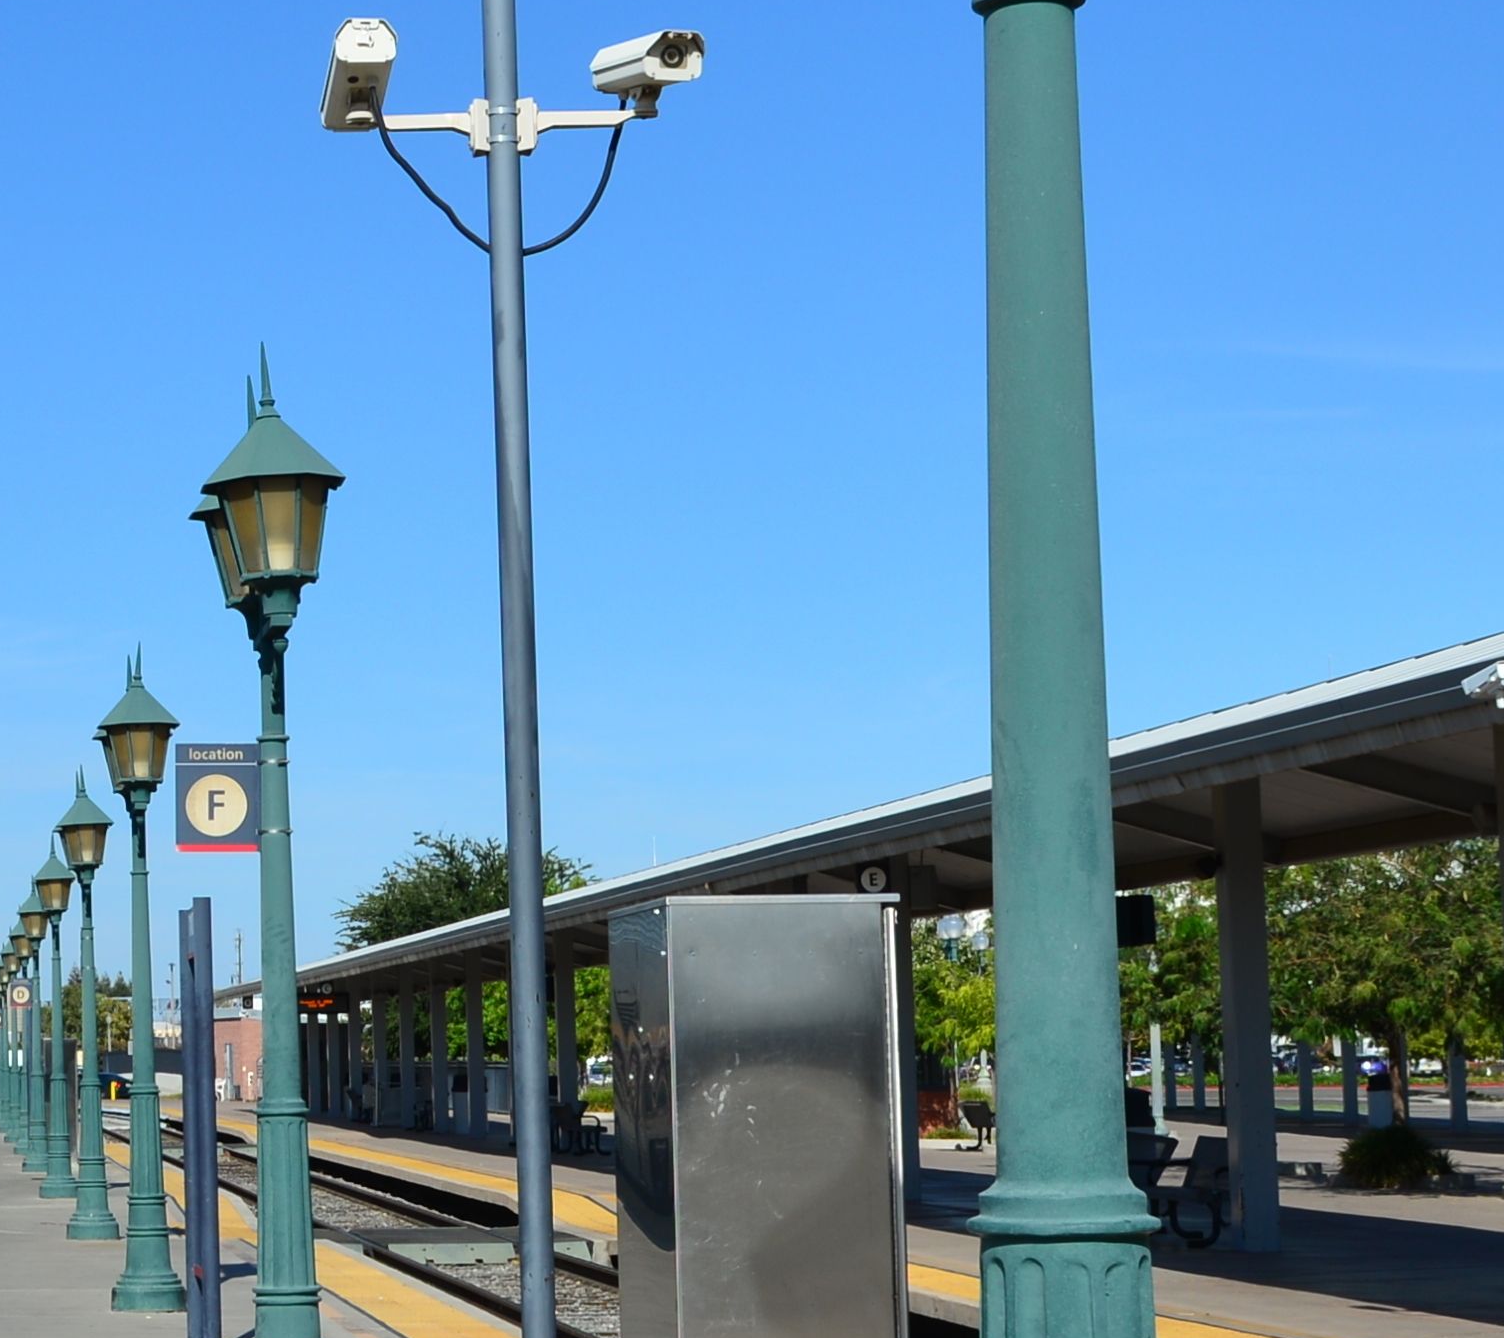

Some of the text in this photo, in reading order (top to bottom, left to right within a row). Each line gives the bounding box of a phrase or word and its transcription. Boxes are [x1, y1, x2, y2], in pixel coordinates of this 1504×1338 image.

[188, 747, 244, 761] location
[207, 789, 226, 821] F
[868, 871, 879, 887] E
[16, 989, 26, 1000] D
